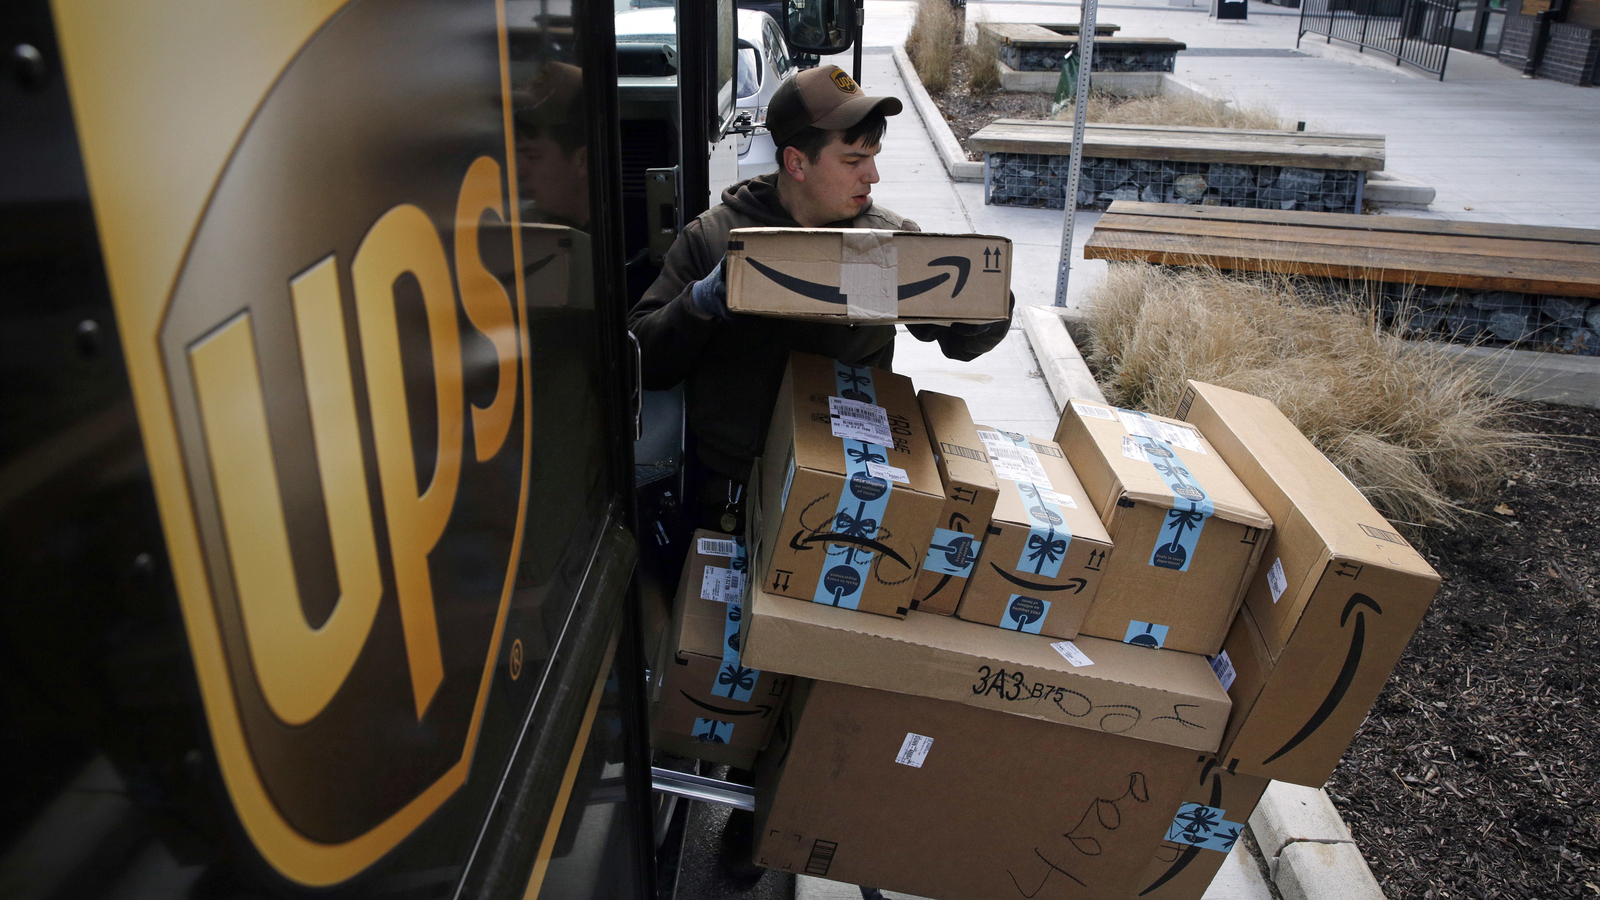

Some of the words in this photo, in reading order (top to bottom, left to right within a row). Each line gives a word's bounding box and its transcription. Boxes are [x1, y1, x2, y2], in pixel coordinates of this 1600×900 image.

[865, 480, 886, 488] shipping
[955, 541, 966, 562] Everything
[972, 665, 1024, 701] 3A3
[1031, 682, 1066, 703] B75
